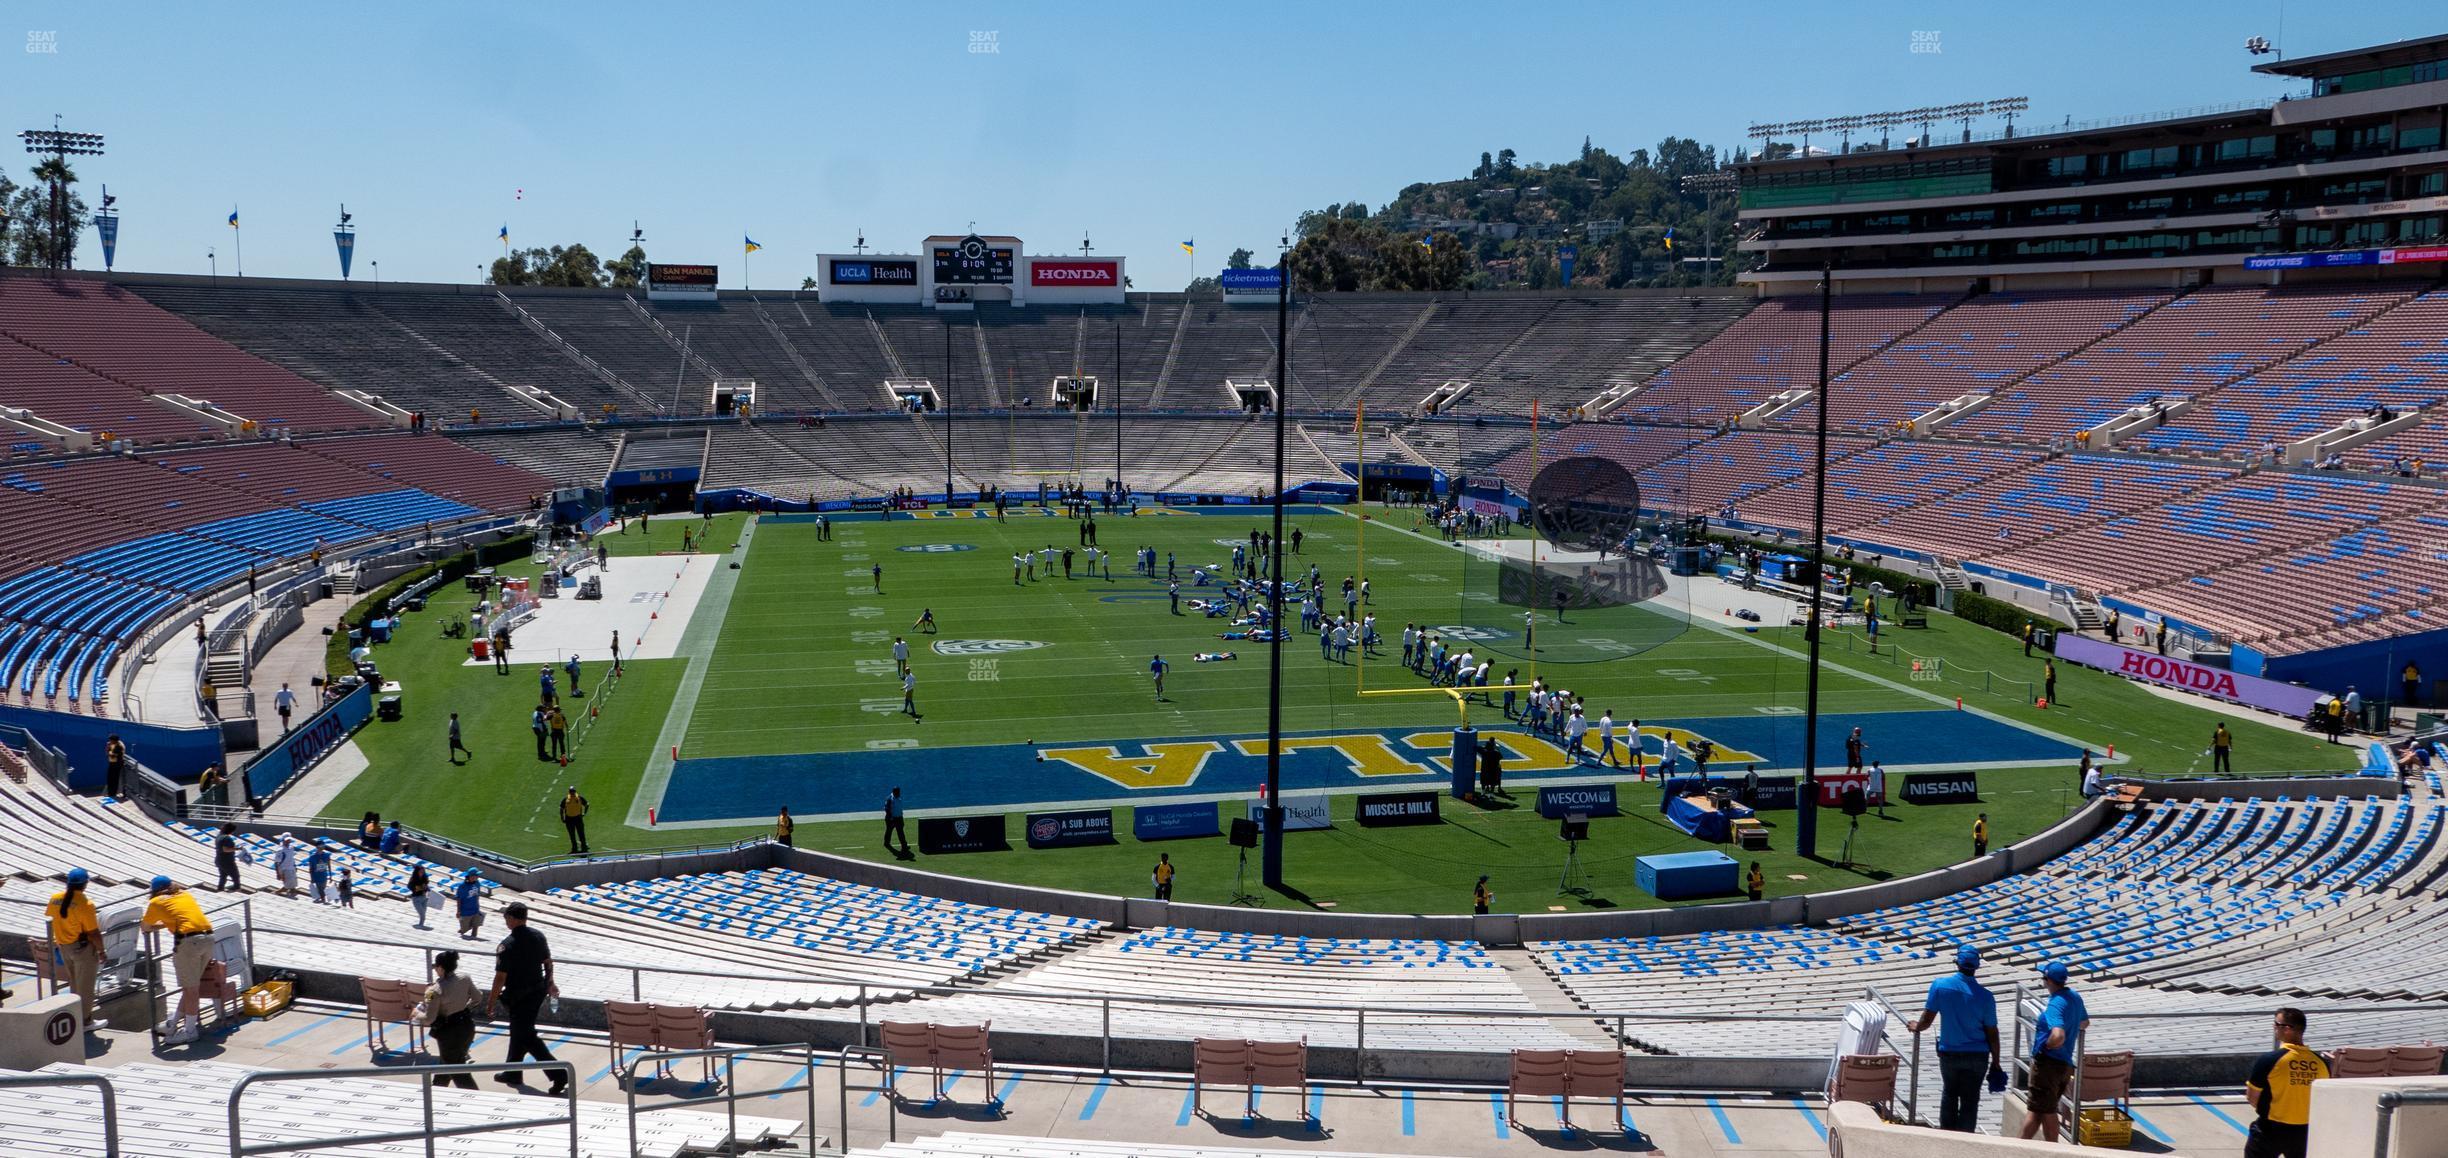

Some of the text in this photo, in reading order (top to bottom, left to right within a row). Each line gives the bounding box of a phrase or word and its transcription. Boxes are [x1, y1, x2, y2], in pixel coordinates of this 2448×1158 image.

[2249, 259, 2277, 268] TOYO
[682, 268, 715, 276] MANUEL
[840, 267, 911, 279] UCLA Health
[1038, 269, 1110, 280] HONDA
[1224, 273, 1283, 283] ticketmaste
[903, 500, 925, 509] TCL
[1475, 501, 1504, 514] HONDA
[2120, 652, 2239, 699] HONDA
[288, 712, 344, 770] HONDA
[1756, 786, 1776, 794] OFFEE
[1910, 781, 1976, 795] NISSAN
[1547, 792, 1598, 804] WESCOM
[1288, 806, 1326, 819] Health
[1365, 801, 1432, 817] MUSCLE MILK
[1062, 817, 1109, 829] A SUB ABOVE
[52, 1018, 71, 1041] 10
[2289, 1060, 2318, 1071] CSC
[2290, 1071, 2318, 1079] EVENT
